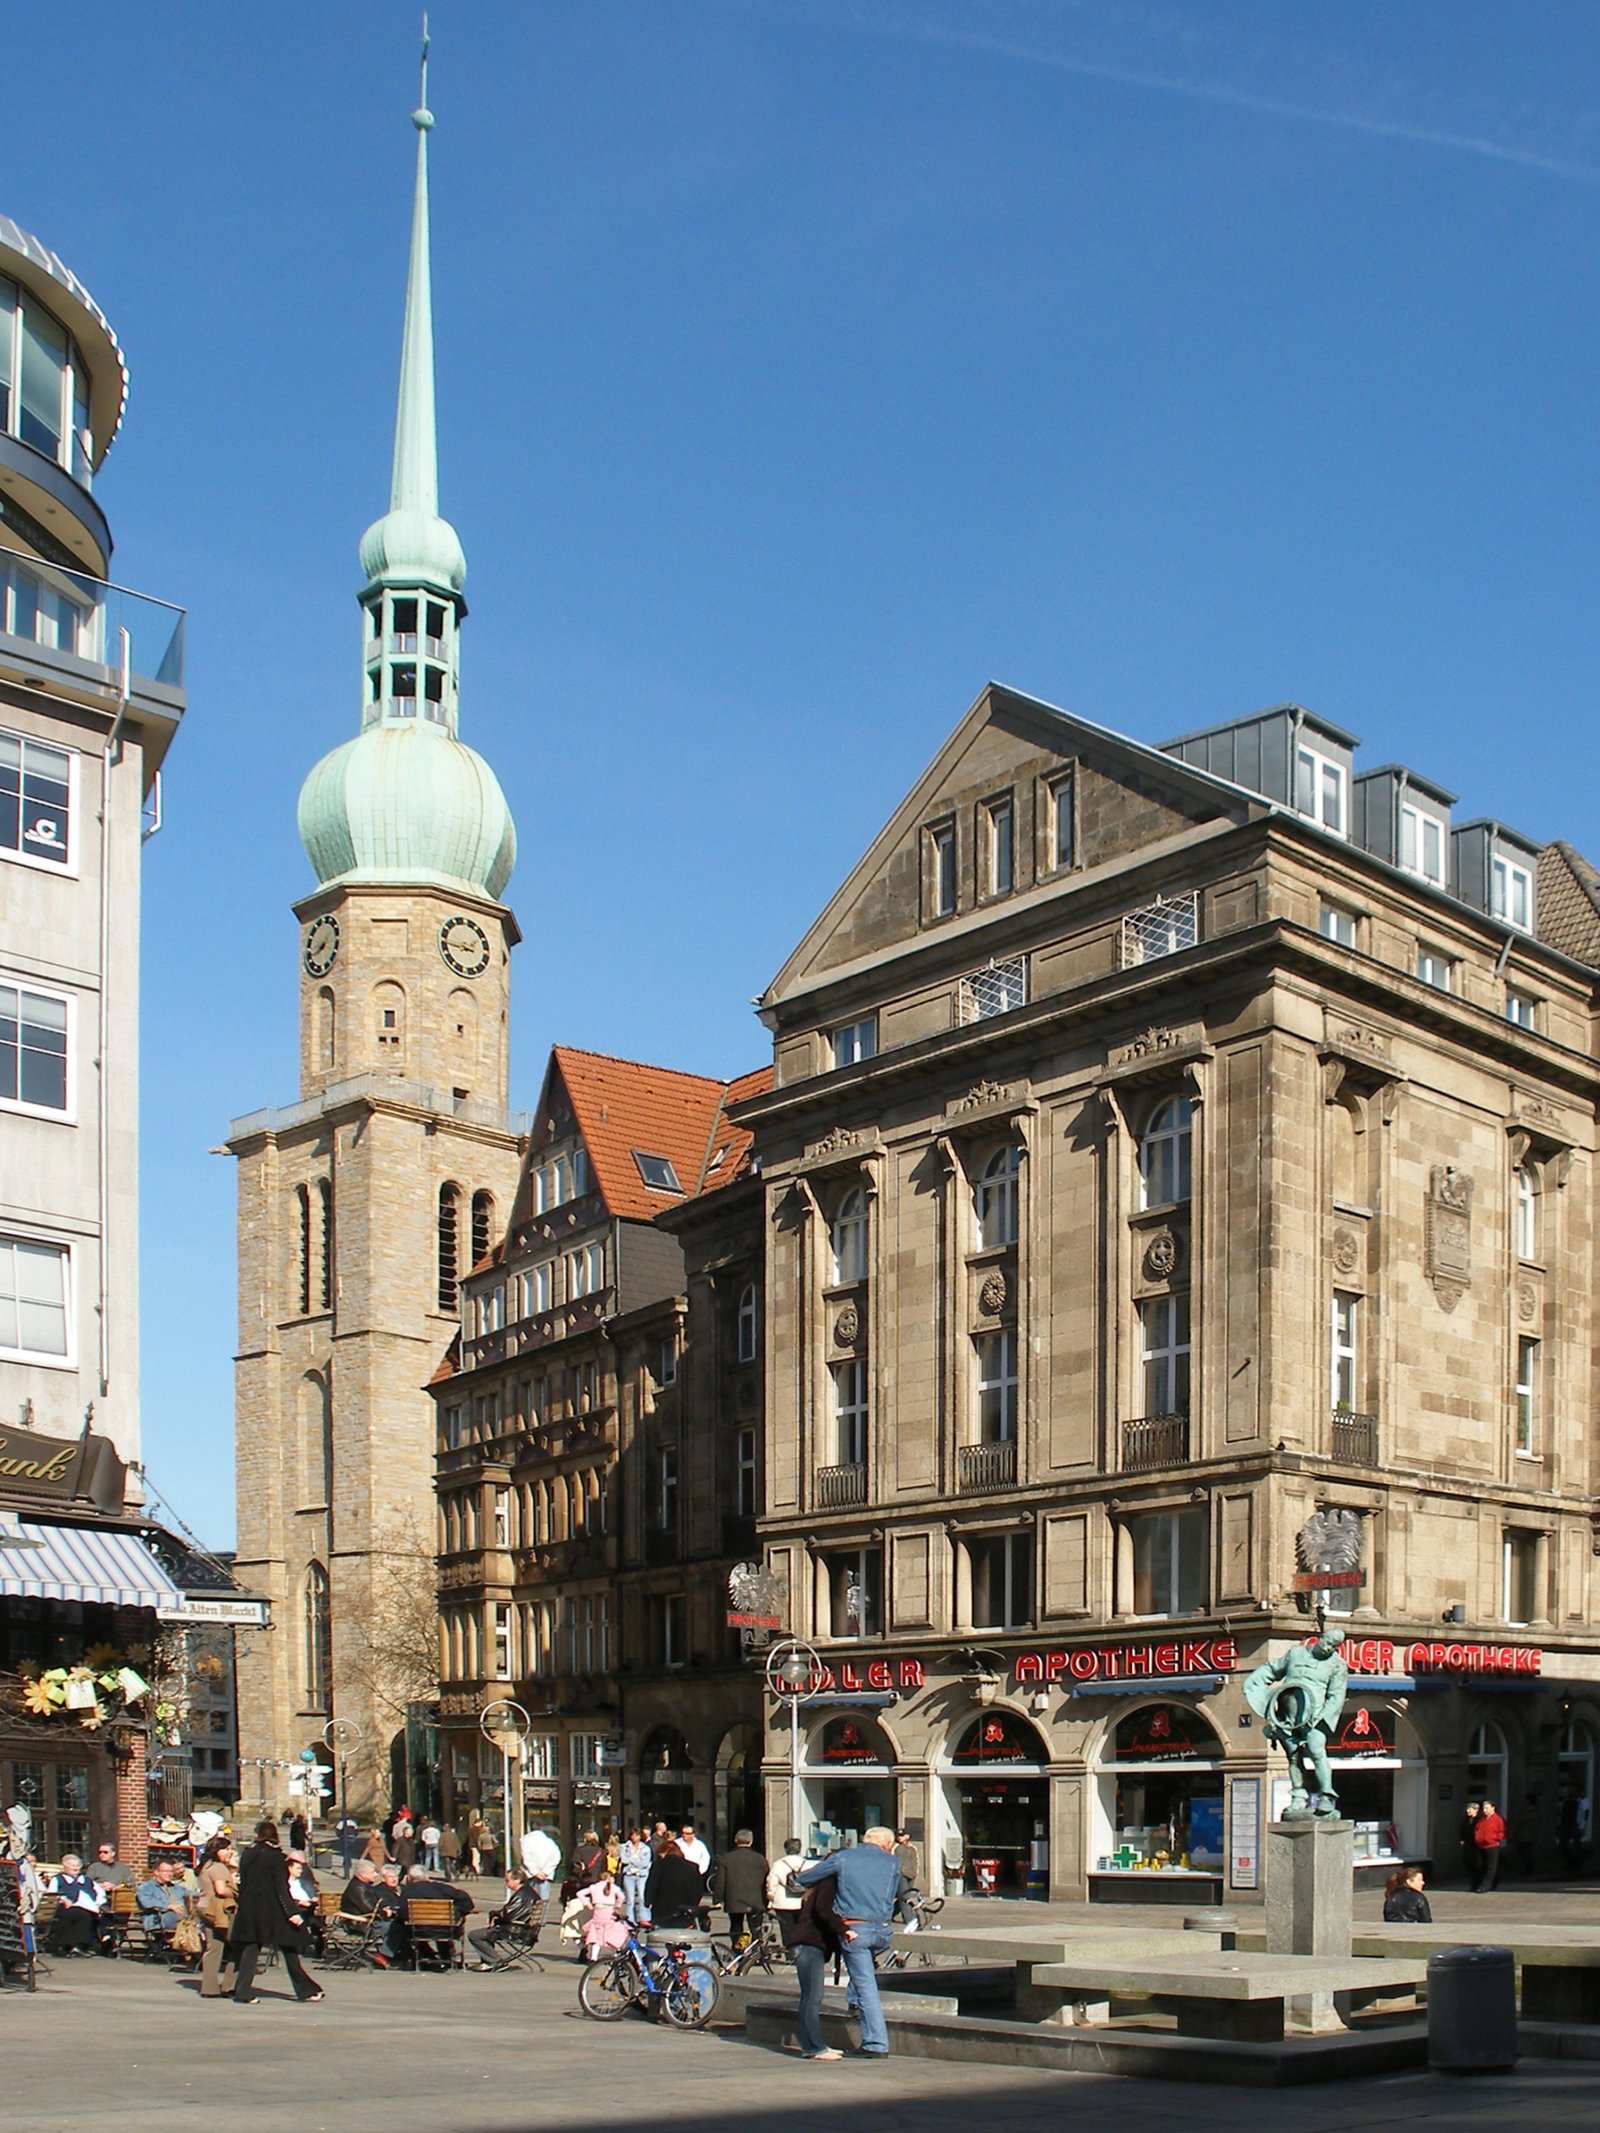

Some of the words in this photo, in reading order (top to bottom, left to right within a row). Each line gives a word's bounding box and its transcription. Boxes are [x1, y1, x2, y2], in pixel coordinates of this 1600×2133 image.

[1294, 1570, 1364, 1588] APOTHEKE
[726, 1613, 781, 1629] APOTHEKE
[1015, 1638, 1238, 1682] APOTHEKE
[1404, 1642, 1543, 1675] APOTHEKE
